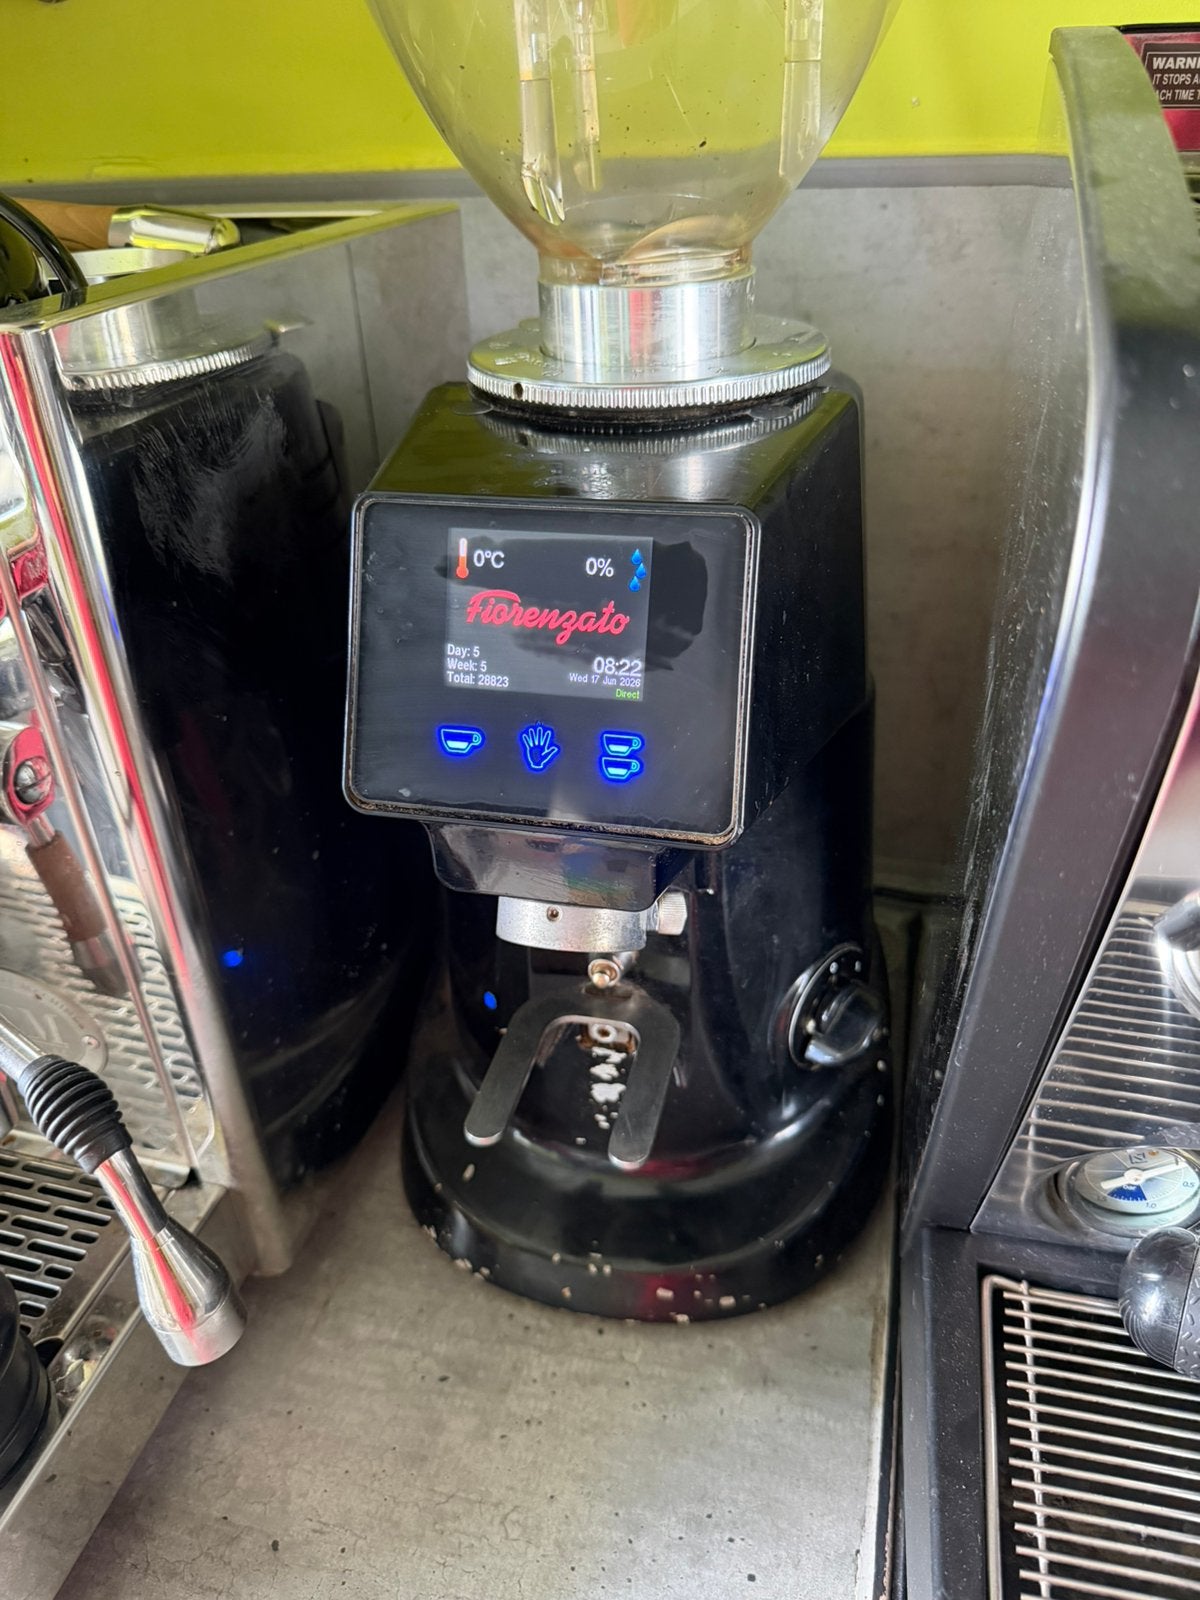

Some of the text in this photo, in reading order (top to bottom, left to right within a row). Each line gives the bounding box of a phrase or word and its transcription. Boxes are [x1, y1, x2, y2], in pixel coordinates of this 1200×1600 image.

[1152, 73, 1200, 85] IT STOPS A
[1174, 89, 1195, 101] TIME
[586, 557, 614, 577] 0%
[466, 589, 630, 645] Fiorenzato
[447, 643, 480, 659] Day: 5
[447, 657, 488, 672] Week: 5
[593, 656, 642, 677] 08:22
[446, 670, 509, 687] Total: 28823
[569, 672, 641, 688] Wed 17 Jun 2026
[615, 688, 640, 699] Direct
